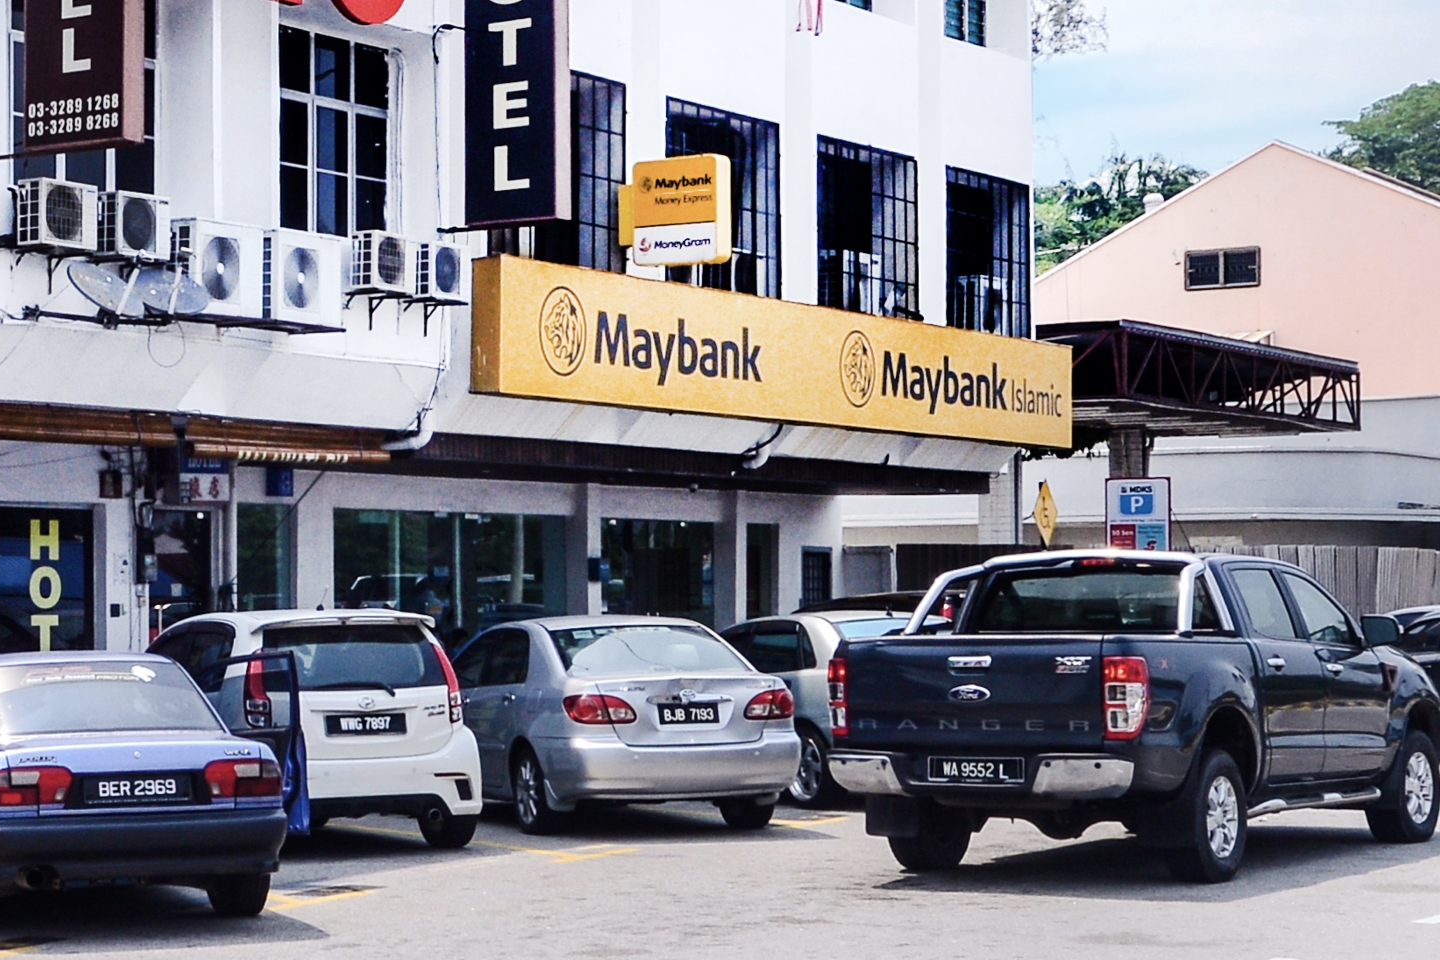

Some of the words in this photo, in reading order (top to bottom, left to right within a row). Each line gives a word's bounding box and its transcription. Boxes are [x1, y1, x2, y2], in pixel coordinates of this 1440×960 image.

[28, 98, 82, 118] 03-3289
[87, 93, 119, 111] 1268
[28, 117, 82, 137] 03-3289
[86, 112, 118, 130] 8268
[654, 173, 712, 190] Maybank
[654, 196, 681, 206] Money
[683, 194, 712, 204] Express
[654, 238, 711, 249] MoneyGram
[594, 310, 763, 387] Maybank
[881, 351, 1008, 415] Maybank
[1011, 379, 1063, 419] Islamic
[1130, 495, 1144, 513] P
[957, 689, 979, 700] Ford
[663, 708, 686, 722] BJB
[689, 707, 714, 720] 7193
[340, 717, 363, 731] WWG
[365, 716, 391, 730] 7897
[859, 718, 1090, 731] RANGER
[943, 761, 958, 777] WA
[961, 761, 995, 779] 9552
[999, 764, 1009, 780] L
[98, 780, 131, 797] BER
[134, 778, 177, 795] 2969
